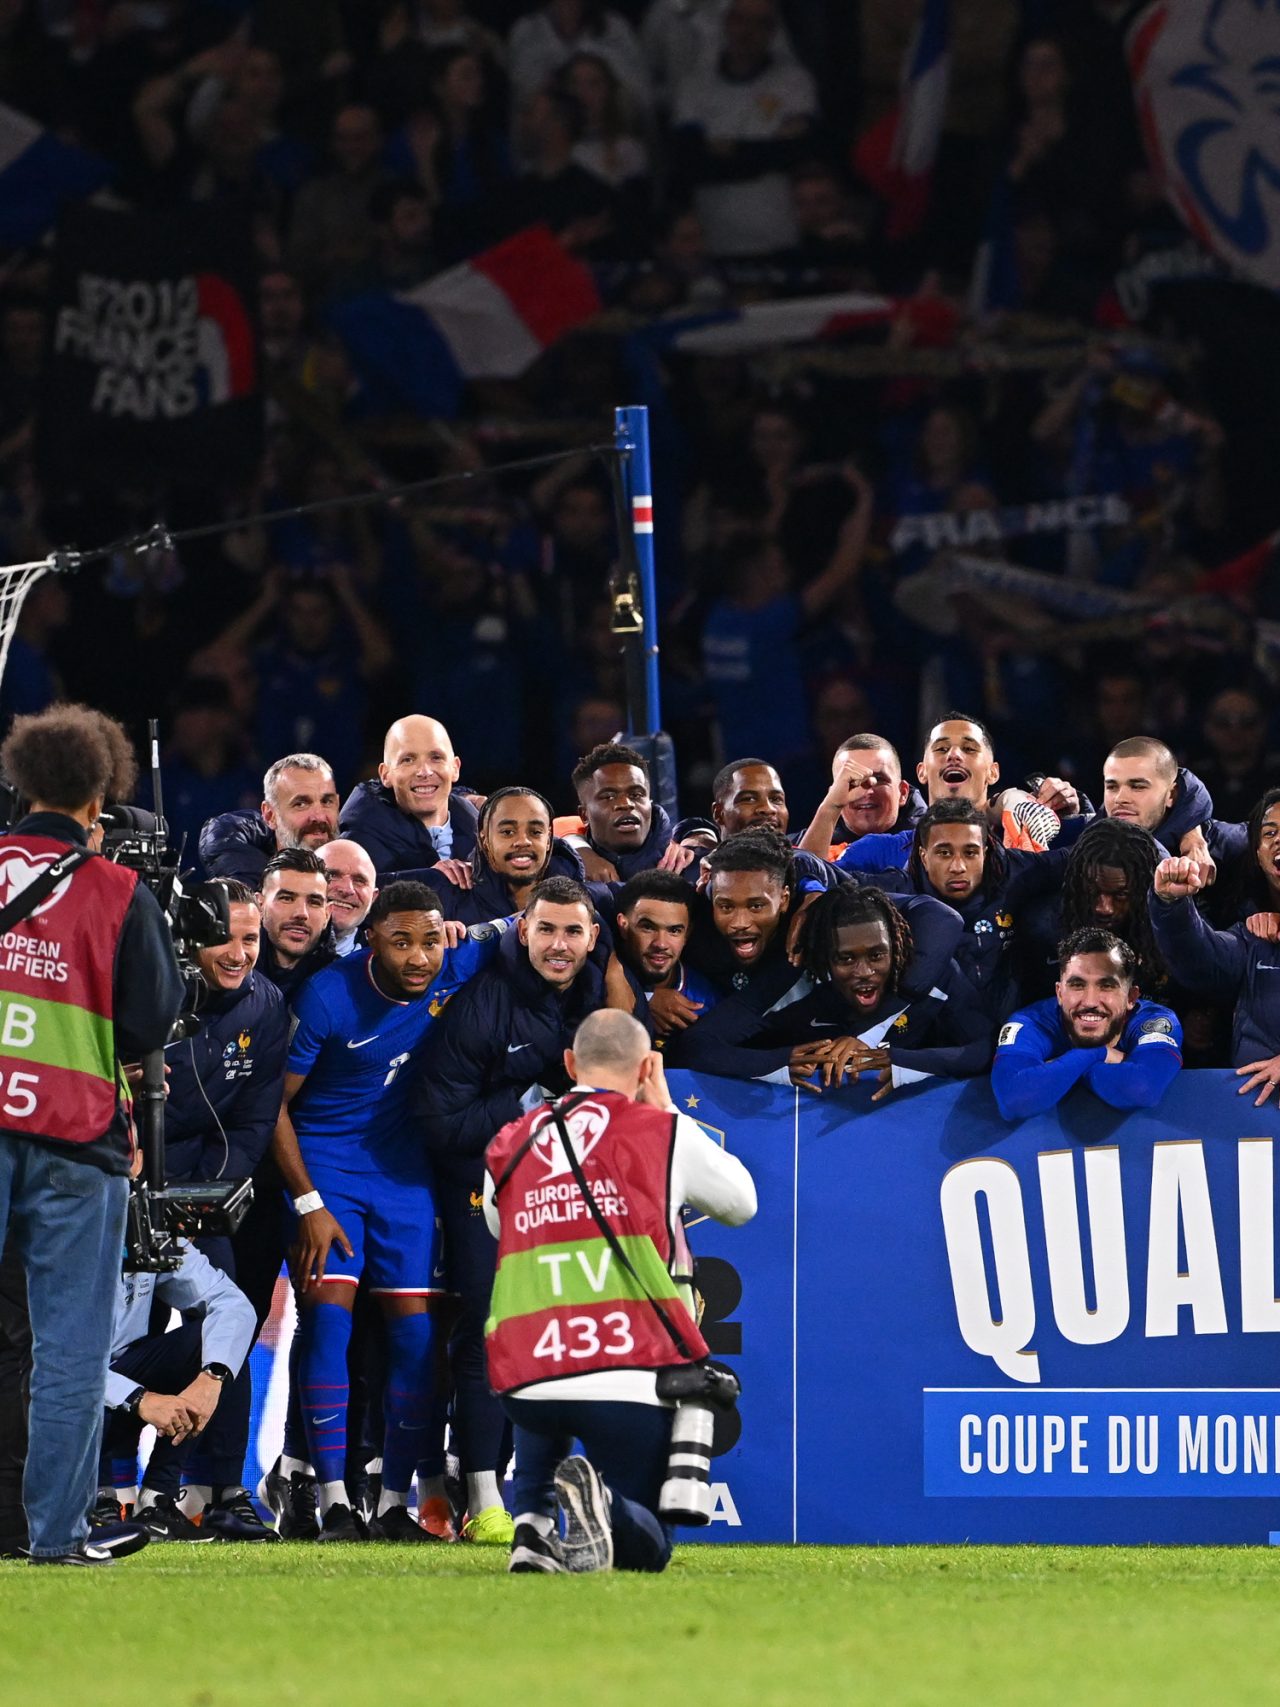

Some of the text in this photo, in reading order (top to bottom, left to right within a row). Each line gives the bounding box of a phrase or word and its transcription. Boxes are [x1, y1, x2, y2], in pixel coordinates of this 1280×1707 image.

[0, 932, 61, 959] OPEAN
[0, 951, 69, 983] IFIERS
[537, 1247, 613, 1297] TV
[532, 1311, 635, 1363] 433
[960, 1414, 1089, 1475] COUPE
[1109, 1415, 1159, 1475] DU
